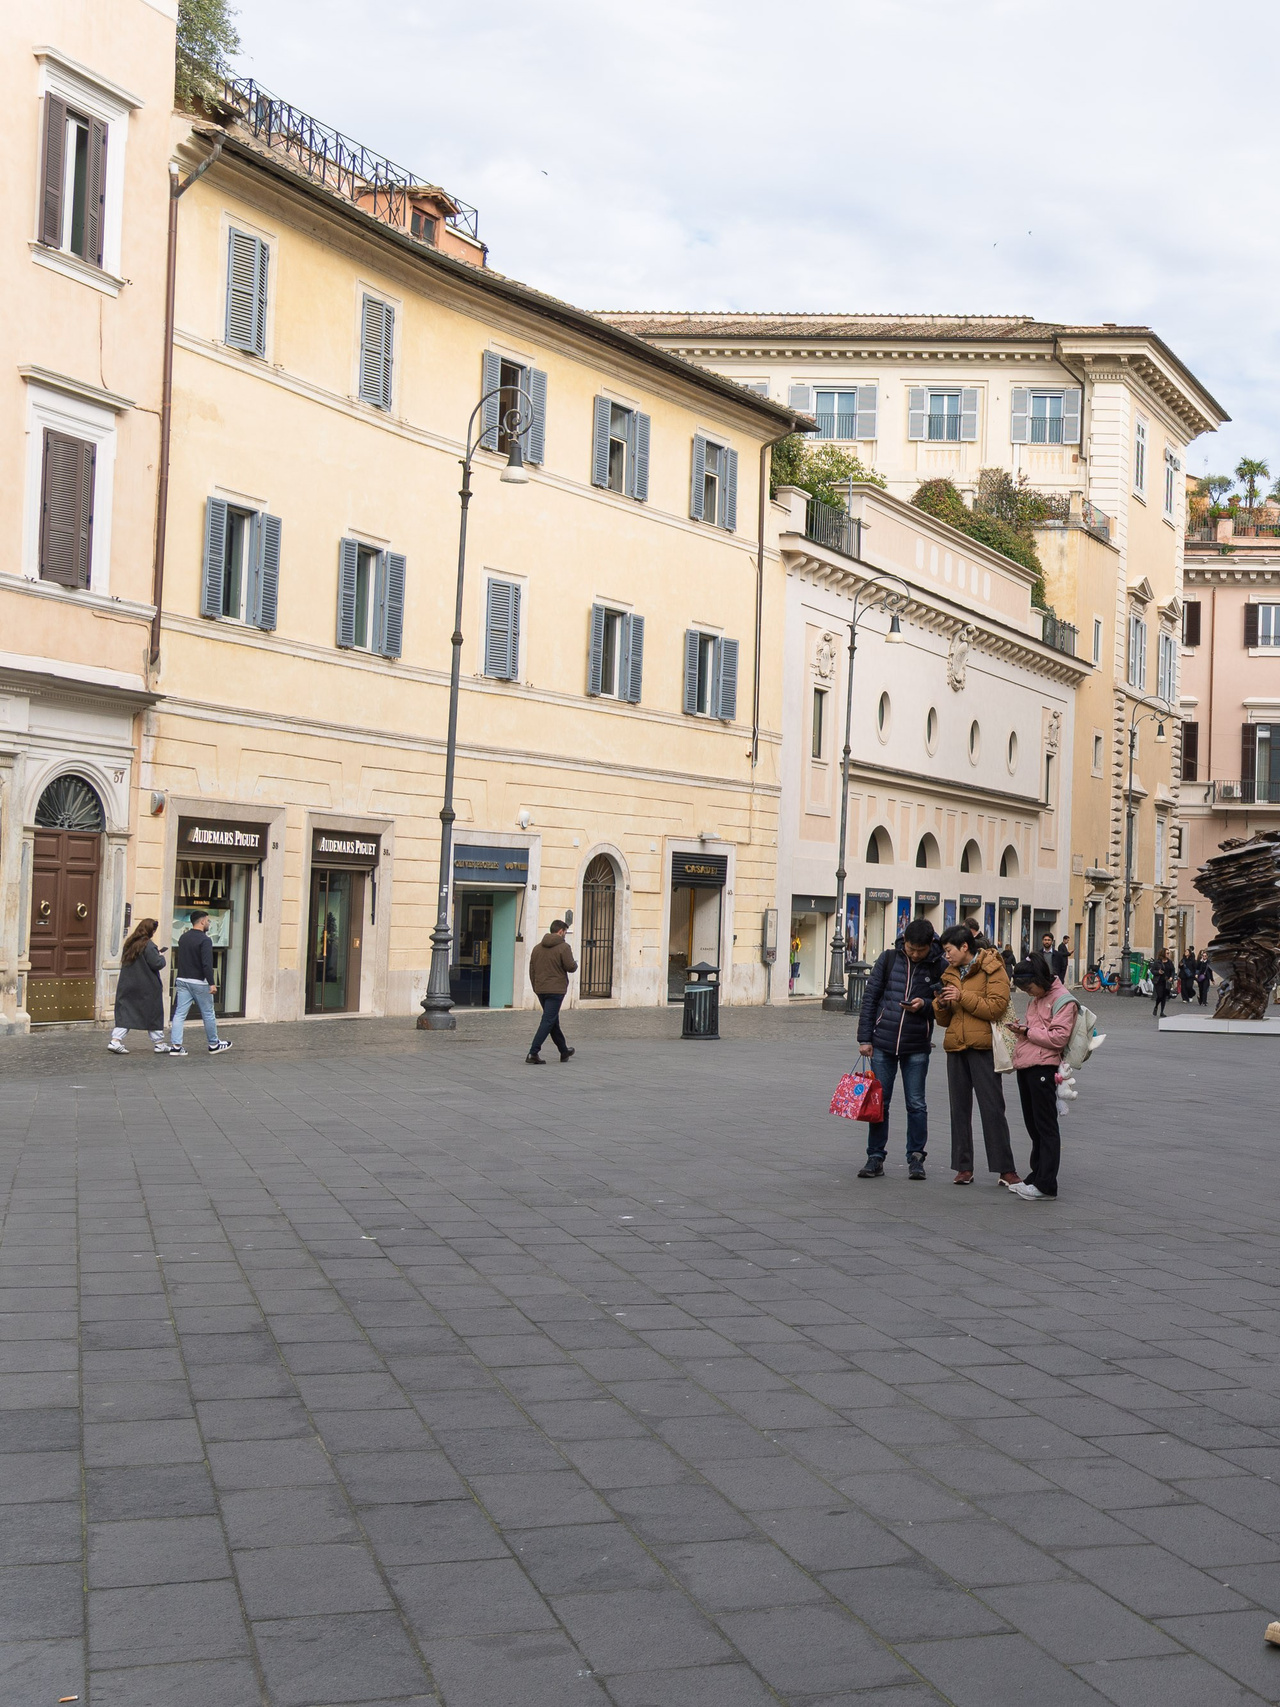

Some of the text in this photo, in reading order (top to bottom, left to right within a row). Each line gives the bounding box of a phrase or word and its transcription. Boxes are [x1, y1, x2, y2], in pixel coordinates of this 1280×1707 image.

[190, 826, 260, 848] AUDEMARS PIGUET
[319, 837, 376, 856] AUDEMARS PIGUET
